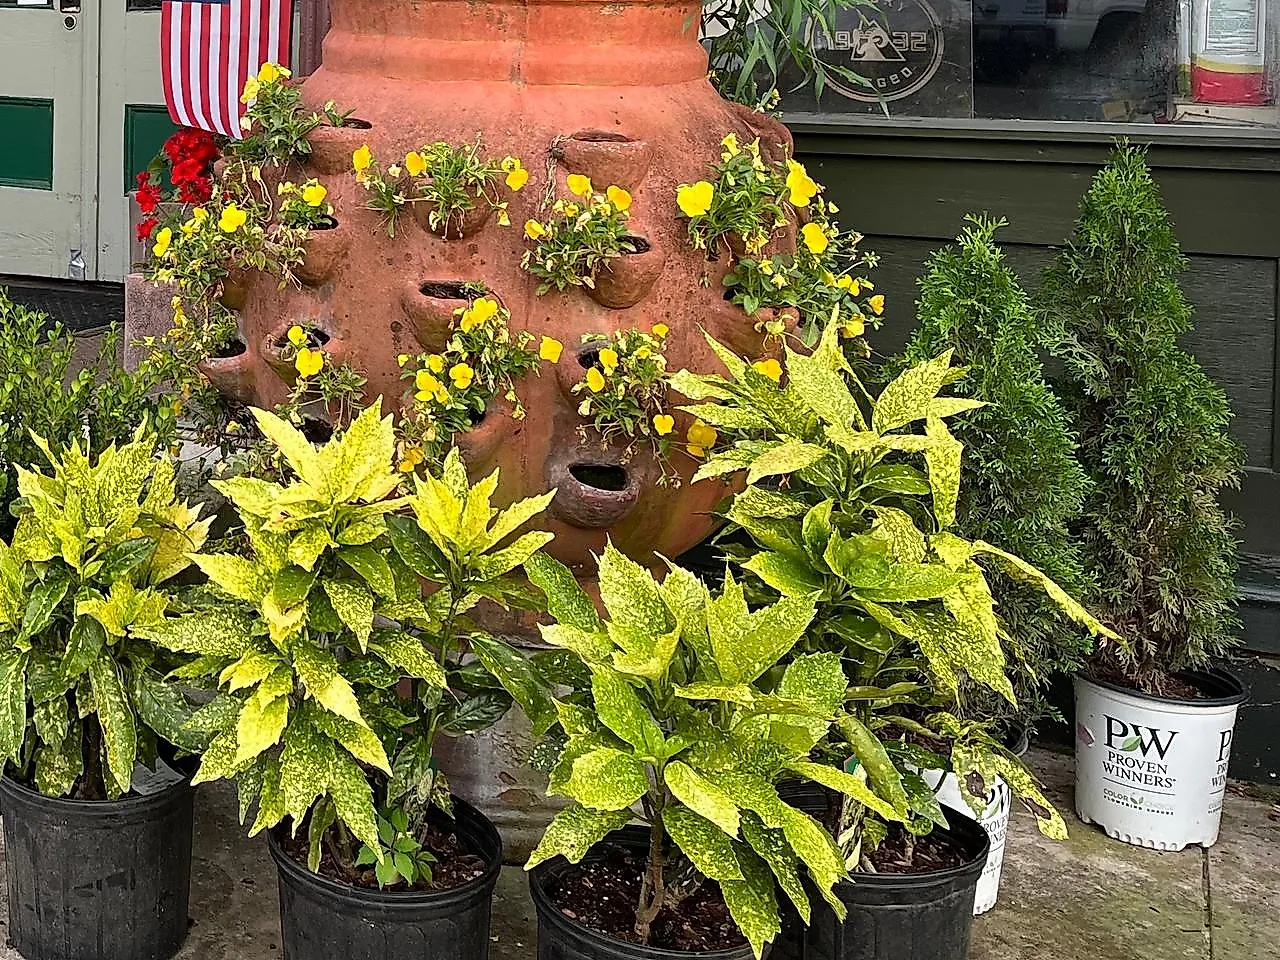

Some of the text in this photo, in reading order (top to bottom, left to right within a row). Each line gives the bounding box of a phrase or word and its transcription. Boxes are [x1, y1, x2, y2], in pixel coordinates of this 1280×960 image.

[1102, 713, 1180, 761] PW
[1102, 760, 1177, 789] WINNERS
[1107, 750, 1168, 776] PROVEN
